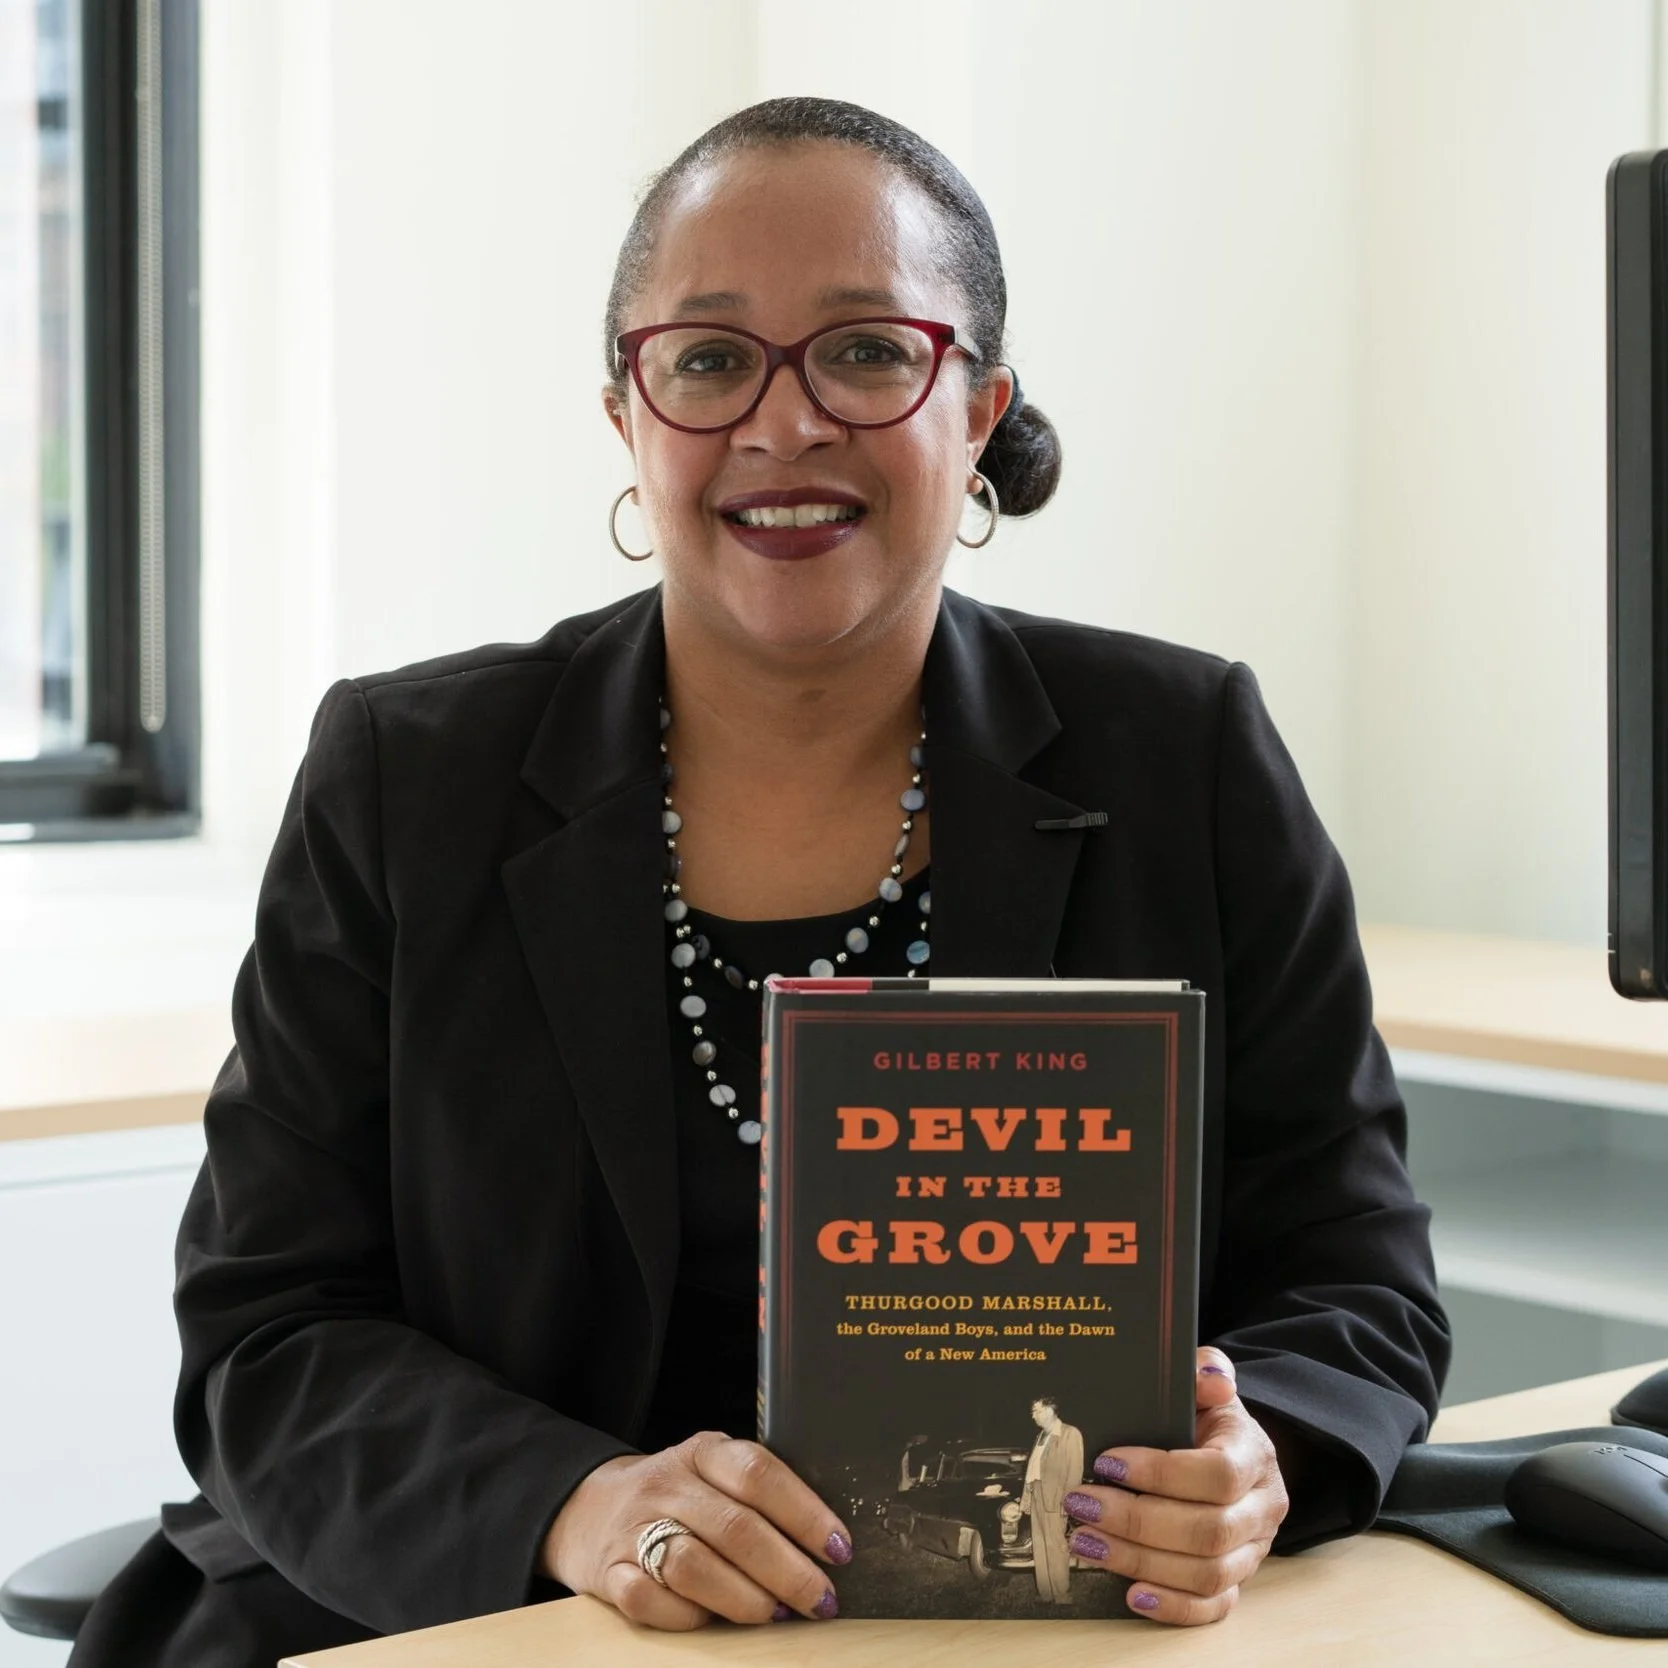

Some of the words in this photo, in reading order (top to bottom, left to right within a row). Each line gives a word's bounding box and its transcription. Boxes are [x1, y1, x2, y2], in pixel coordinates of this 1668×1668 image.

[874, 1052, 1000, 1070] GILBERT
[1016, 1052, 1087, 1070] KING
[836, 1107, 1132, 1152] DEVIL
[896, 1176, 947, 1198] IN
[963, 1176, 1062, 1198] THE
[816, 1220, 1139, 1265] GROVE
[845, 1295, 974, 1311] THURGOOD
[982, 1296, 1112, 1312] MARSHALL,
[836, 1322, 863, 1336] the
[866, 1321, 951, 1336] Groveland
[954, 1321, 999, 1338] Boys,
[1002, 1323, 1034, 1336] and
[1037, 1323, 1065, 1336] the
[1068, 1323, 1116, 1337] Dawn
[904, 1347, 922, 1361] of
[925, 1349, 936, 1361] a
[939, 1347, 976, 1361] New
[979, 1347, 1047, 1361] America
